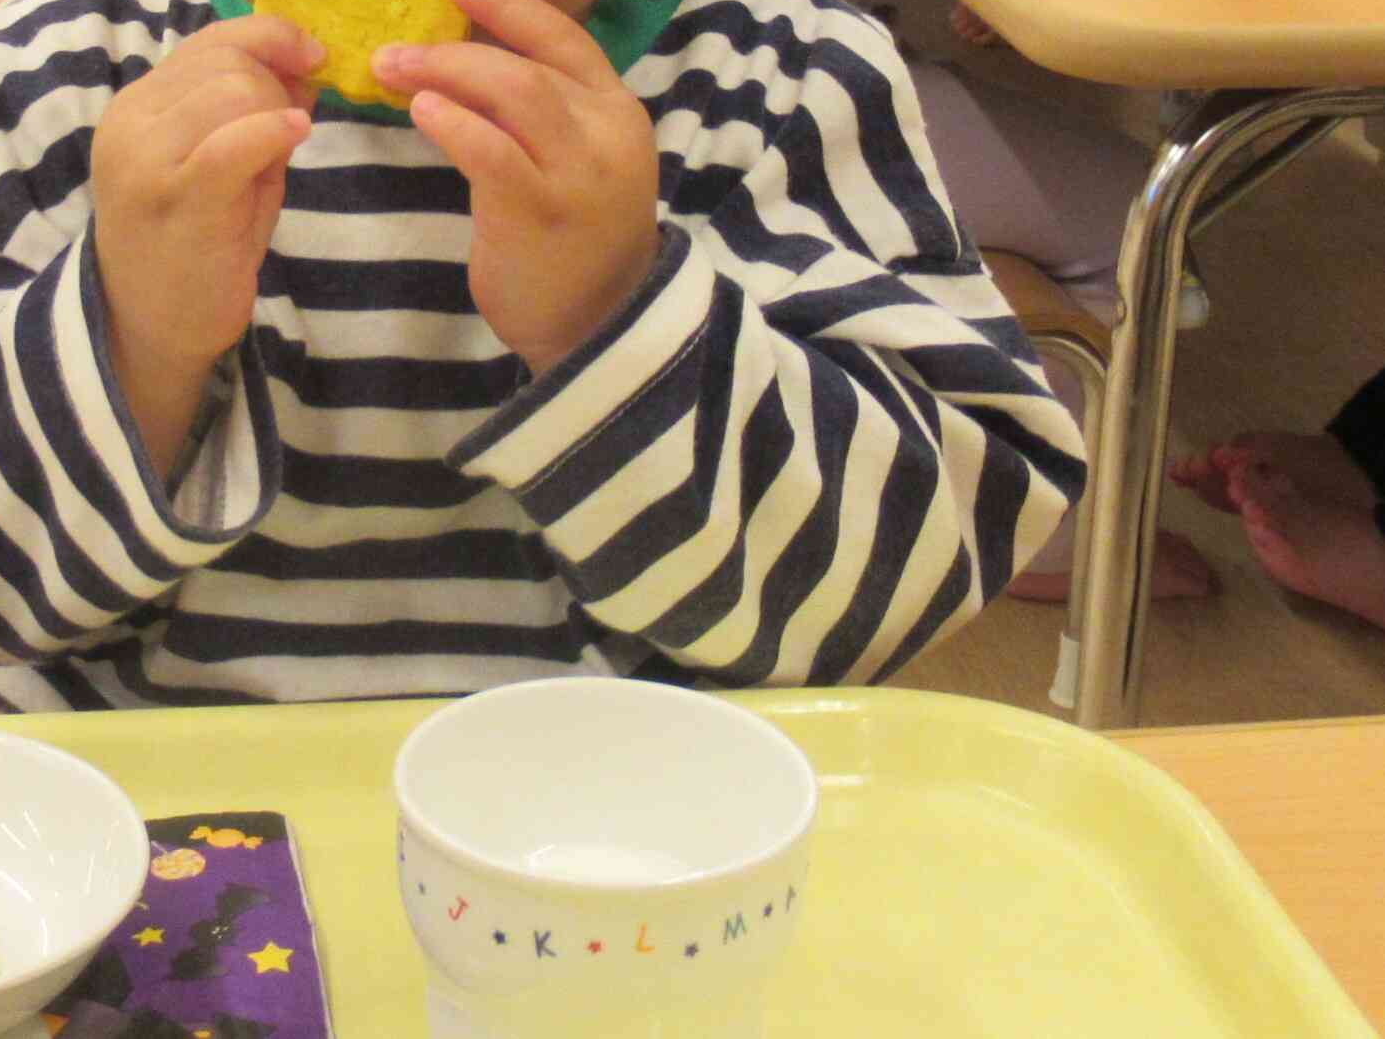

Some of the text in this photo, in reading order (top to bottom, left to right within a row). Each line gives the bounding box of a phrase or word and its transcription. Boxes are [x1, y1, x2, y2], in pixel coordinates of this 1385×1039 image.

[533, 930, 557, 959] K
[635, 921, 655, 952] L
[722, 911, 748, 946] M
